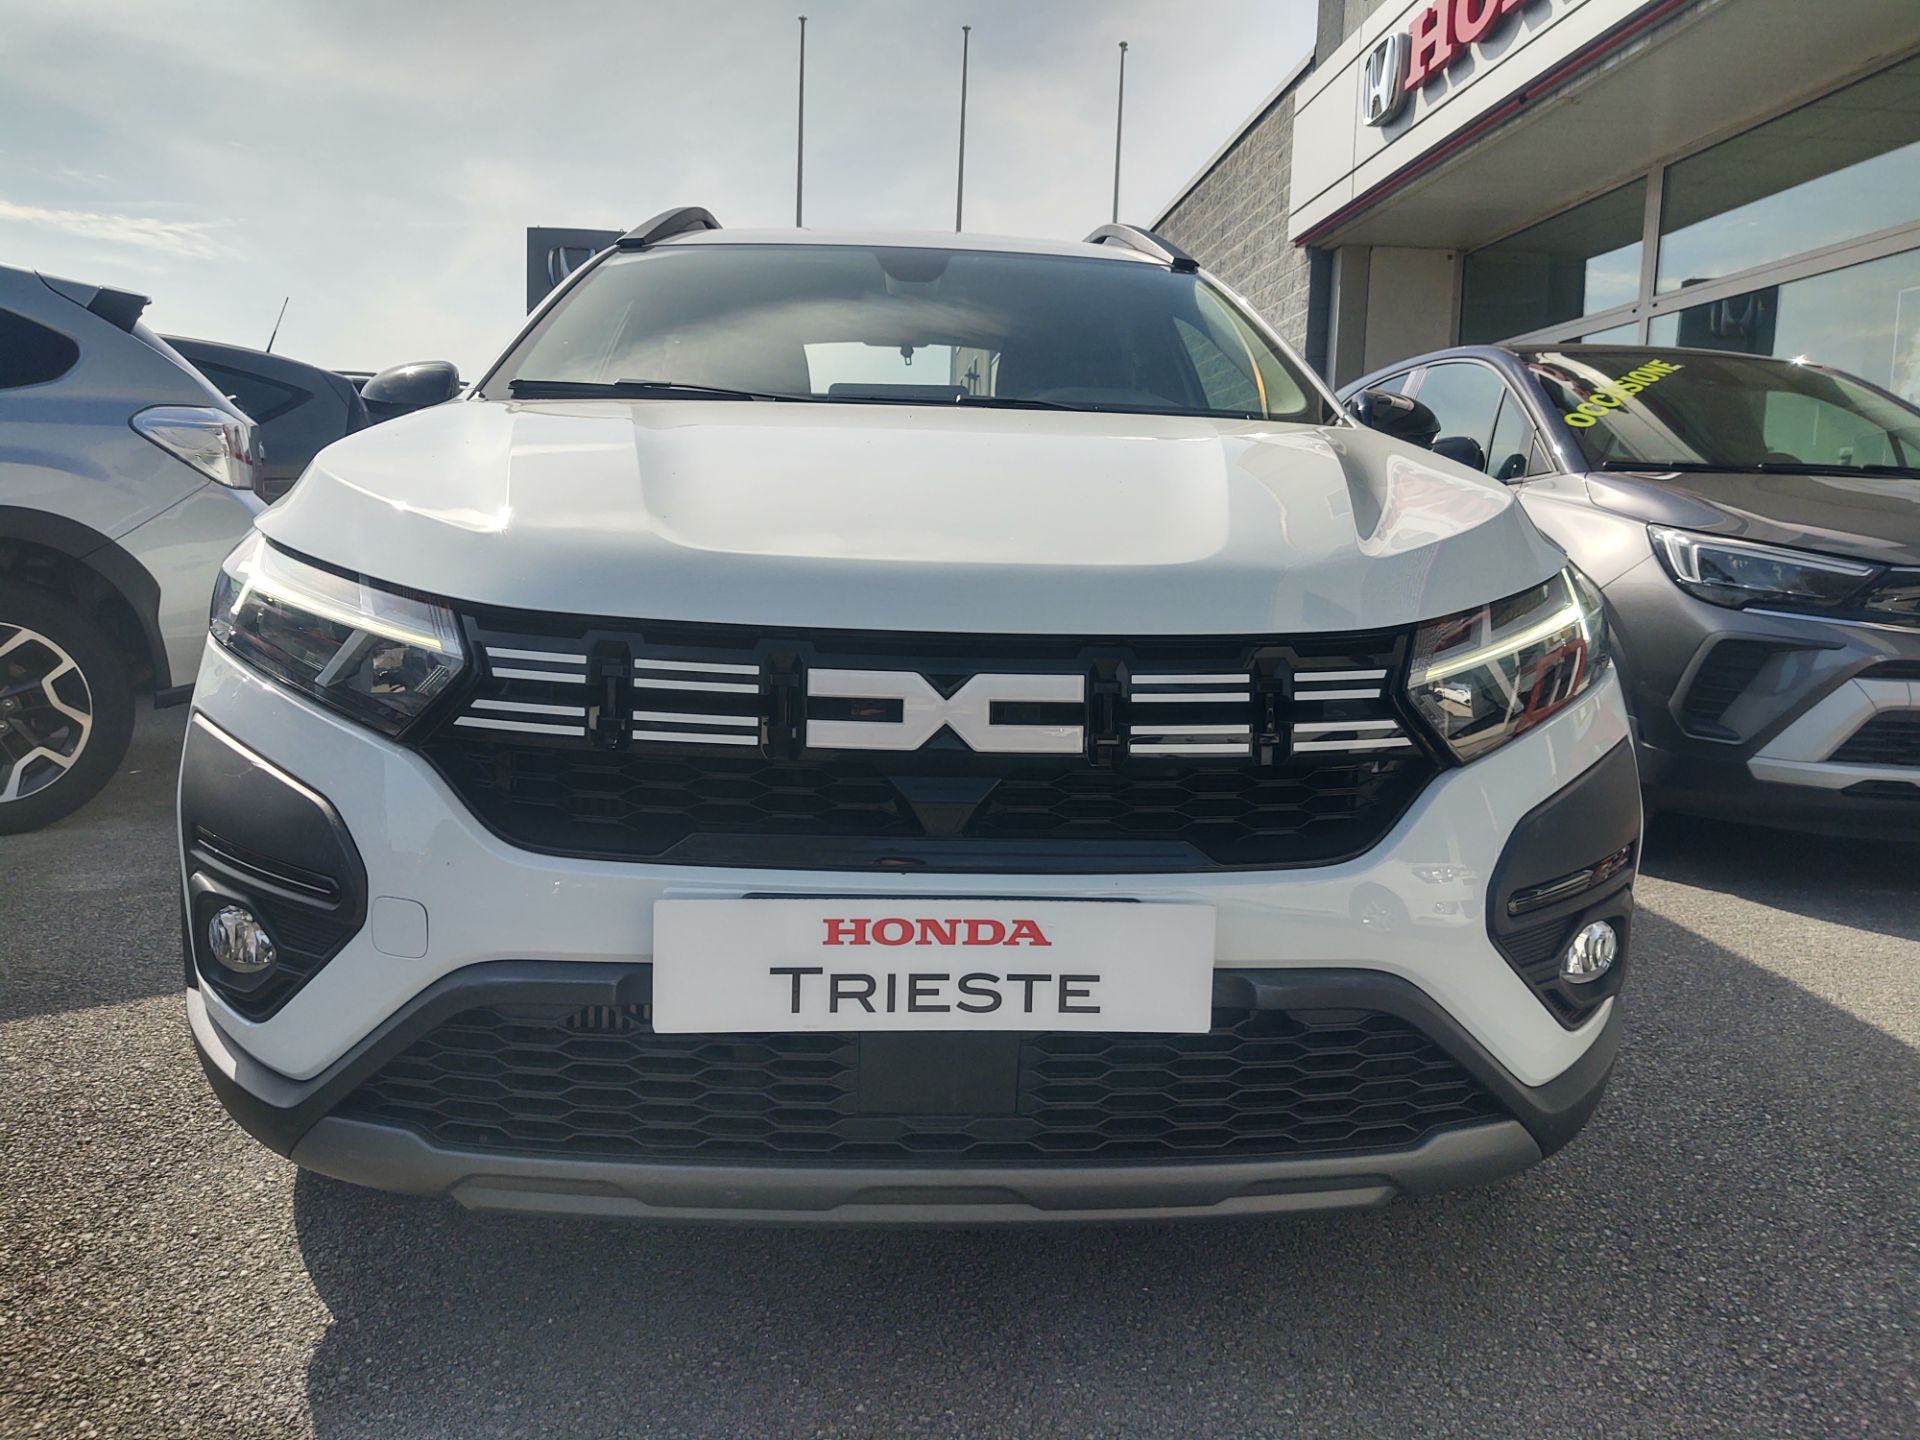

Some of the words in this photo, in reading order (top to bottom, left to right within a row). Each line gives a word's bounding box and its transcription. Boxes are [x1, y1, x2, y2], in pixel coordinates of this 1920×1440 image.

[1404, 0, 1524, 91] HO
[1563, 358, 1686, 428] OCCASIONE
[822, 917, 1052, 947] HONDA
[769, 966, 1101, 1014] TRIESTE
